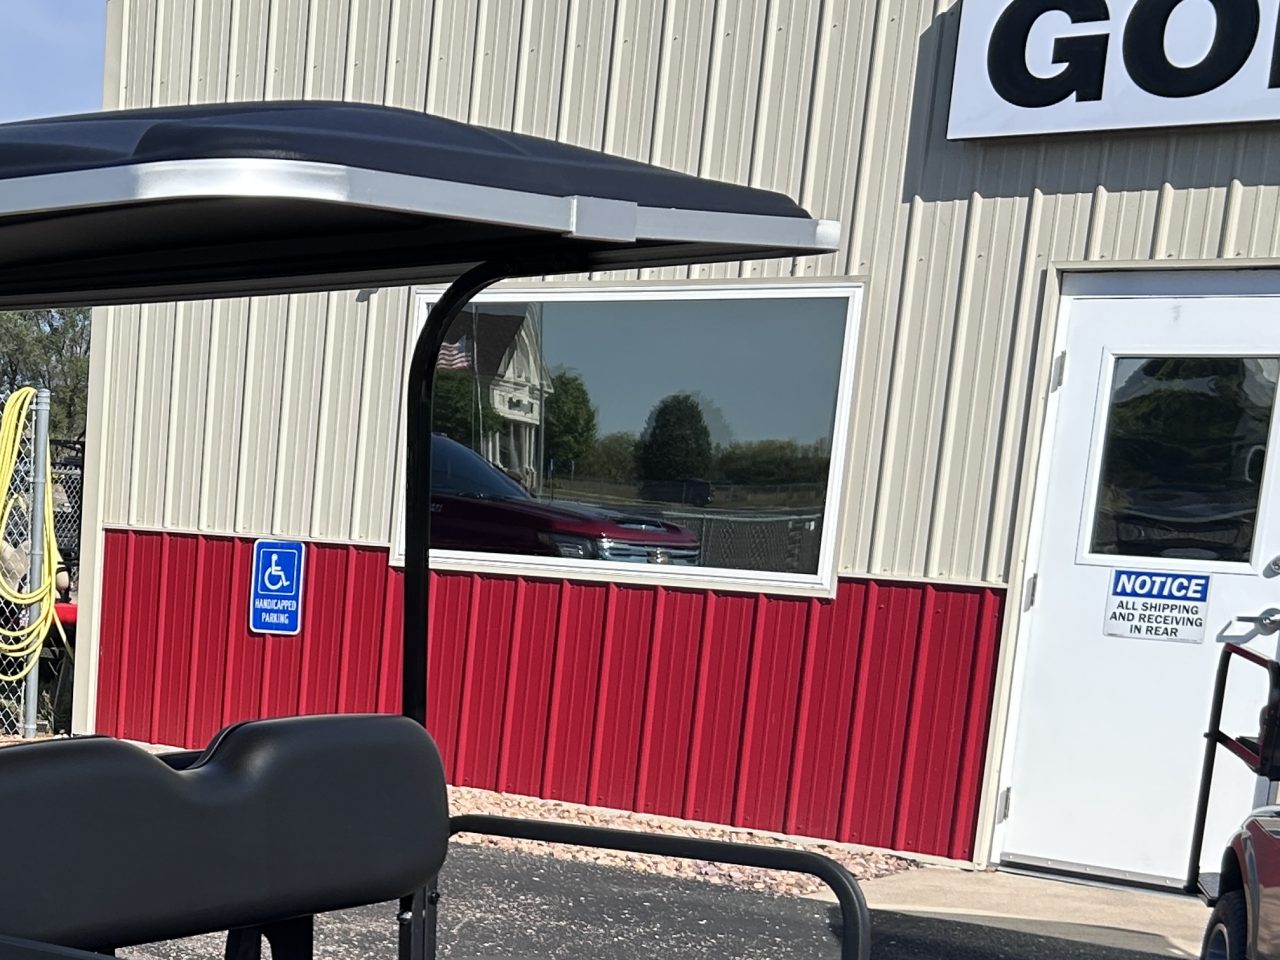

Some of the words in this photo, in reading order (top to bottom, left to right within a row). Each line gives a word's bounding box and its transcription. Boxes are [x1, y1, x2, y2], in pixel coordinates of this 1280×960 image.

[987, 0, 1280, 108] GO
[1116, 574, 1206, 598] NOTICE
[255, 598, 297, 611] HANDICAPPED
[1116, 600, 1138, 611] ALL
[1141, 602, 1199, 615] SHIPPING
[261, 612, 289, 624] PARKING
[1109, 611, 1135, 622] AND
[1138, 613, 1203, 628] RECEIVING
[1130, 624, 1142, 634] IN
[1145, 625, 1179, 637] REAR
